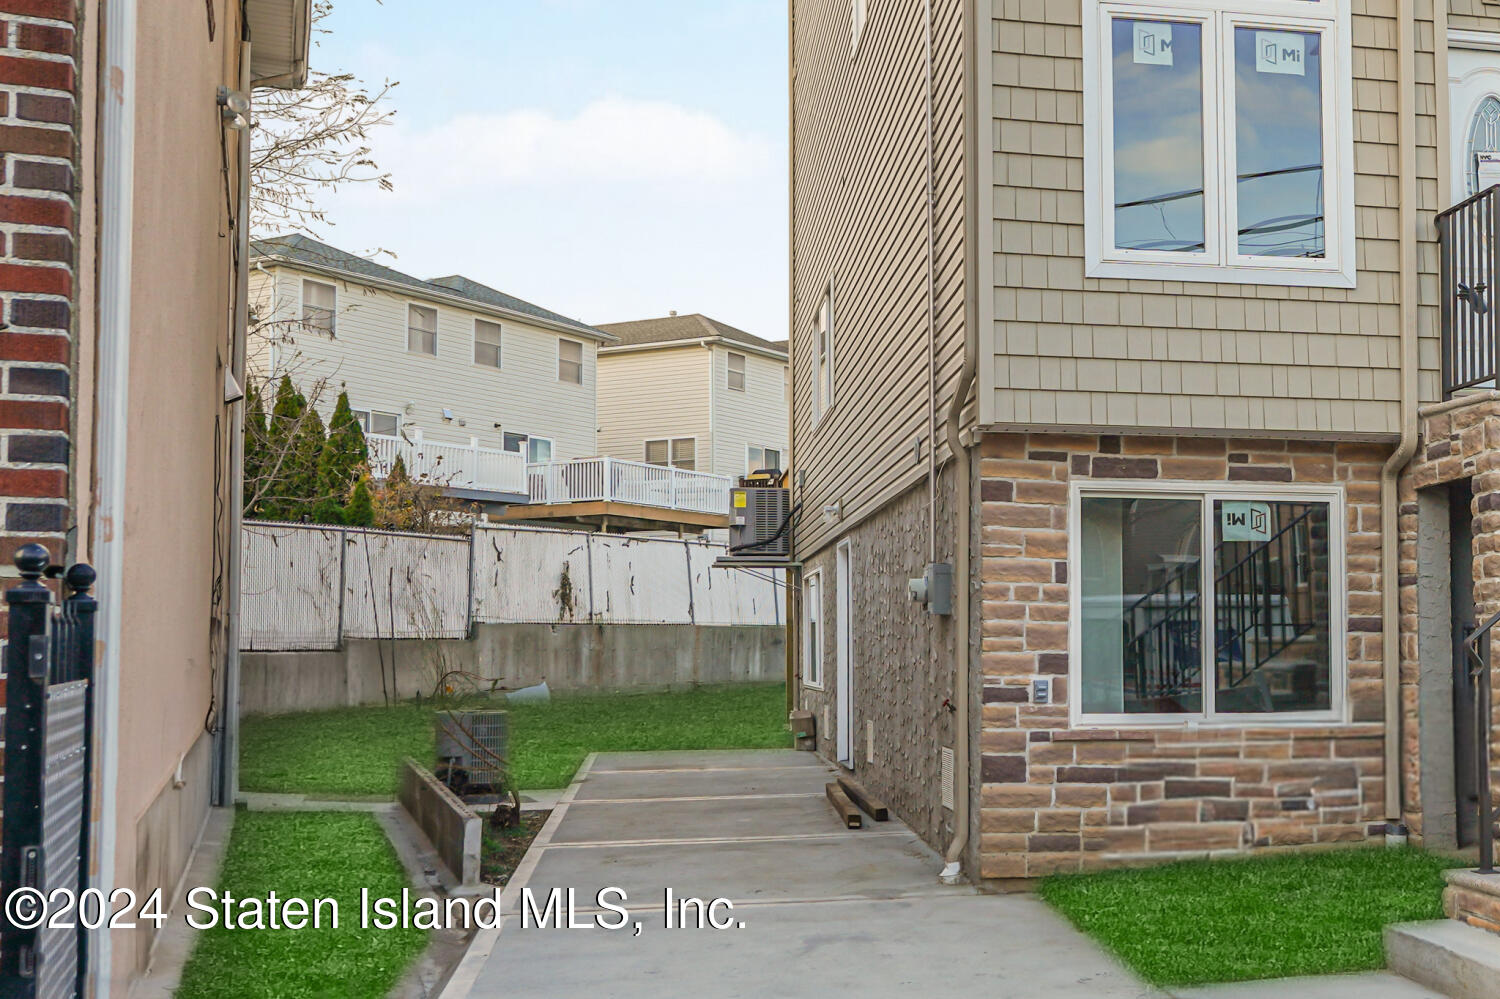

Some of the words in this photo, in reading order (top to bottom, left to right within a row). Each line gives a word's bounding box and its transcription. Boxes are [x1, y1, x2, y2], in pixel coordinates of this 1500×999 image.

[1161, 38, 1172, 53] M
[1282, 48, 1300, 63] Mi
[1227, 512, 1246, 526] Mi
